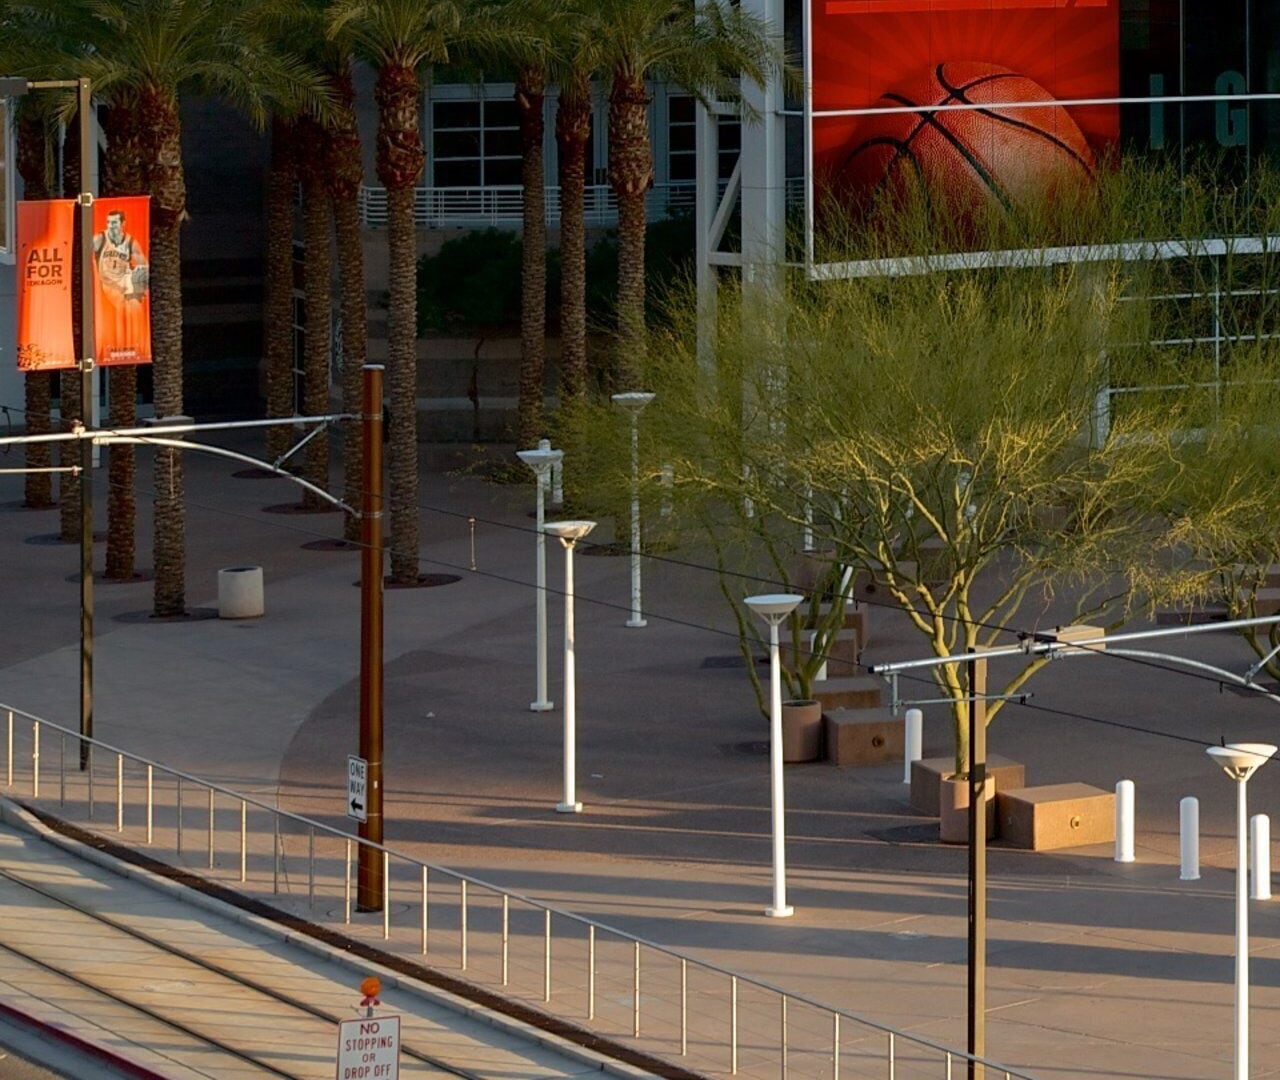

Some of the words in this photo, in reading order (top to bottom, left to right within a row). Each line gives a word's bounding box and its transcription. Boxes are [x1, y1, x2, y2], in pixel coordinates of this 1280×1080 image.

[28, 248, 63, 263] ALL
[26, 265, 63, 279] FOR
[350, 762, 364, 779] ONE
[350, 780, 365, 796] WAY
[360, 1022, 380, 1036] NO
[345, 1035, 393, 1052] STOPPING
[362, 1052, 376, 1063] OR
[345, 1066, 371, 1080] DROP
[374, 1064, 391, 1077] OFF
